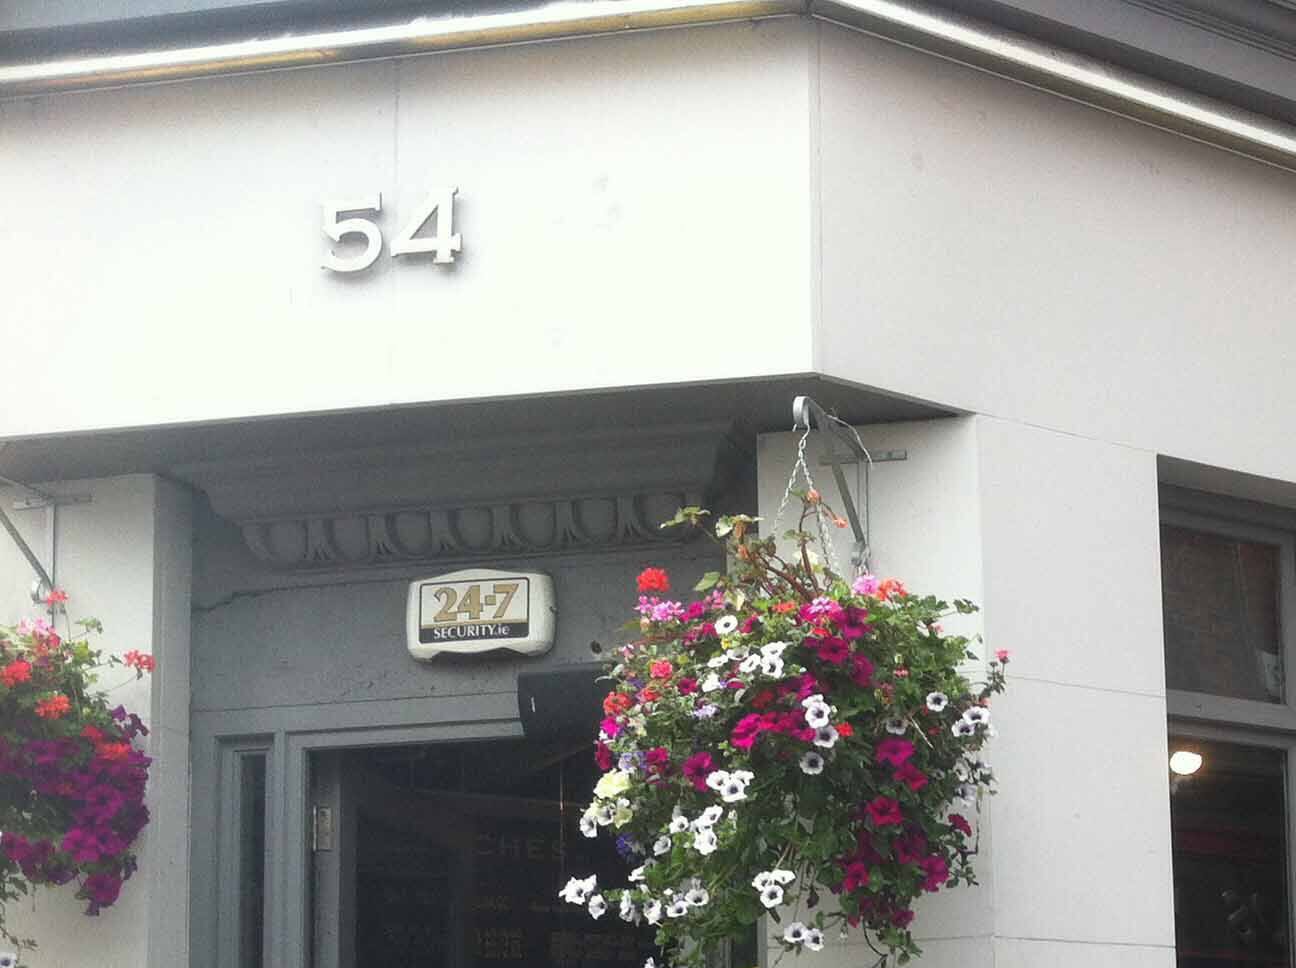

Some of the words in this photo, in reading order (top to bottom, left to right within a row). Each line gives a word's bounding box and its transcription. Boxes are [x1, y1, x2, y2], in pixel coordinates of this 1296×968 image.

[320, 187, 463, 272] 54
[433, 583, 520, 623] 24-7
[432, 623, 511, 641] SECURITY.ie
